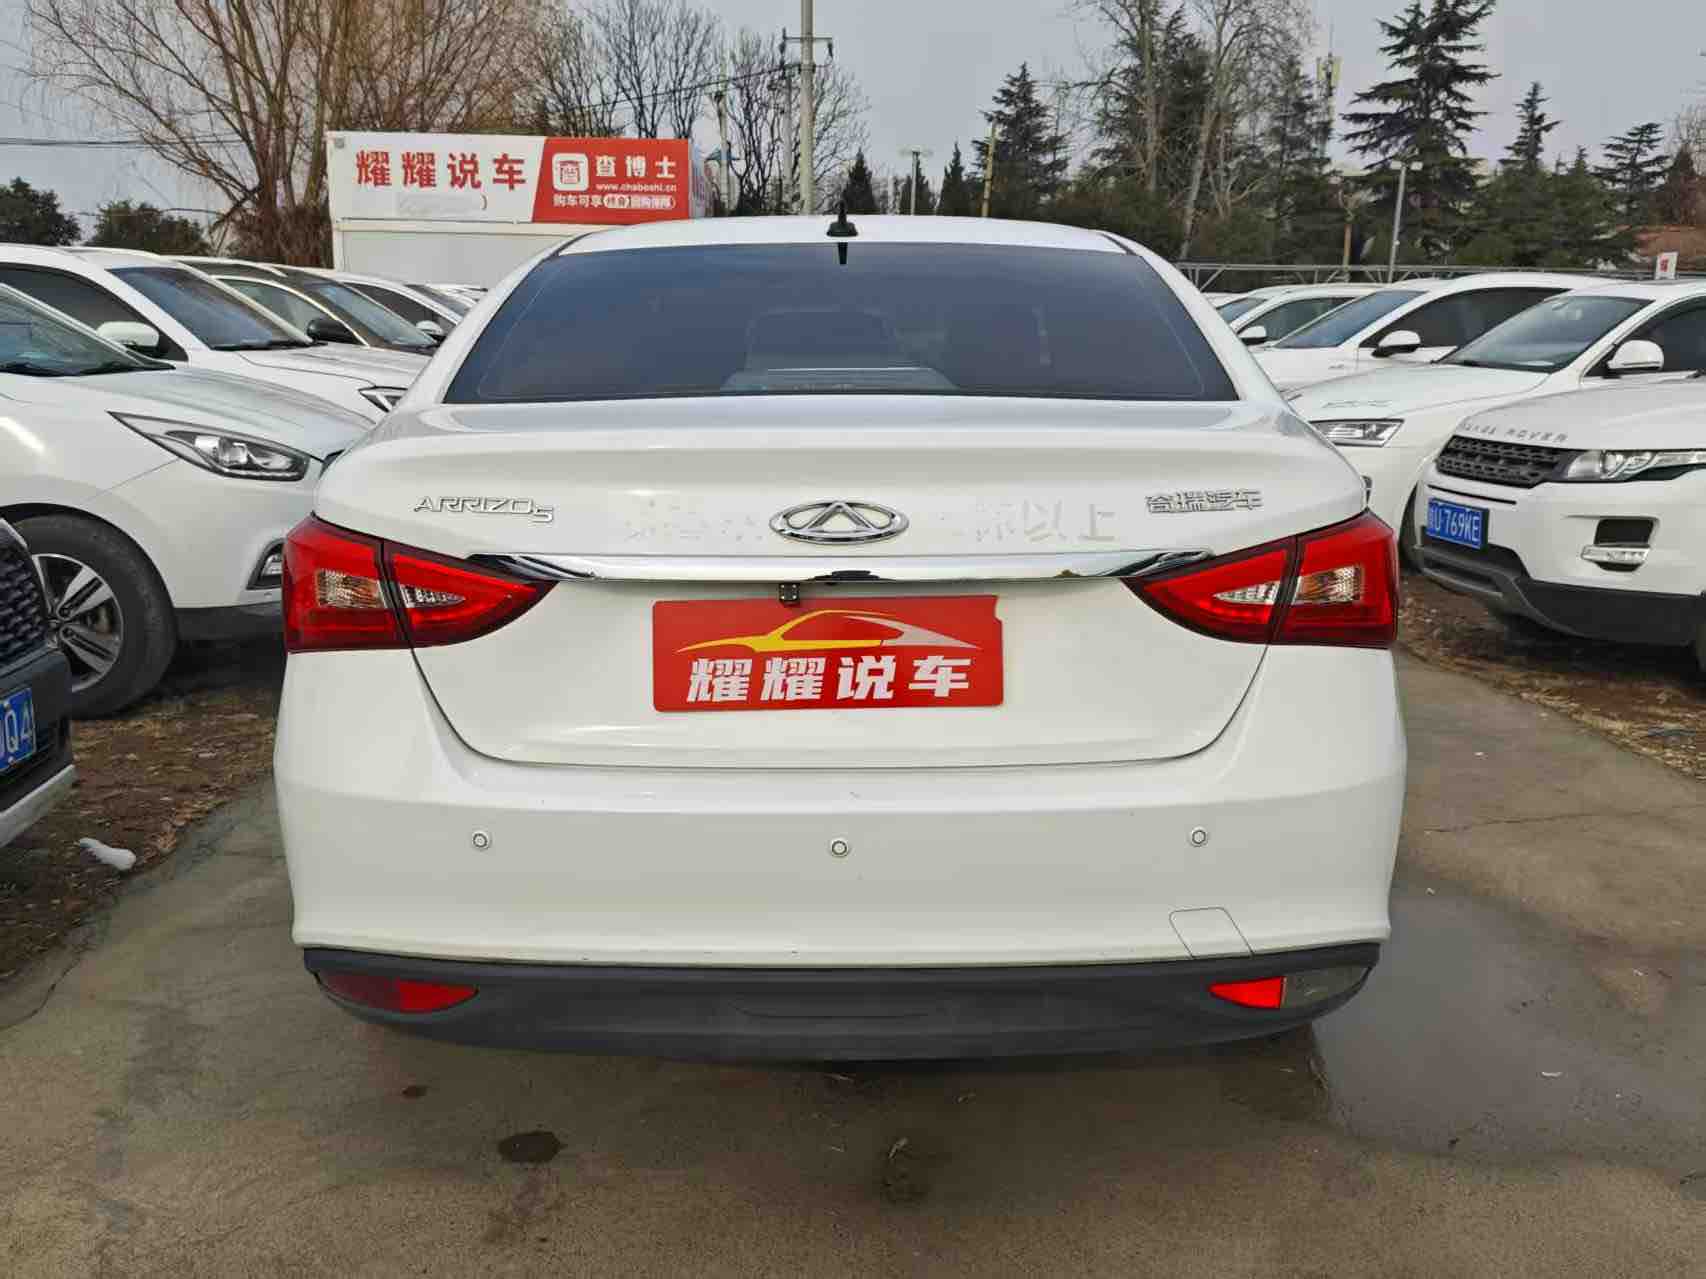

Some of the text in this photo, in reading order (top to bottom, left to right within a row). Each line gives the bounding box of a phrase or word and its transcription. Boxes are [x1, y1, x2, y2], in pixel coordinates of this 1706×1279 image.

[356, 150, 526, 190] 耀耀说车
[595, 155, 677, 179] 查博士
[686, 655, 972, 703] 耀耀说车
